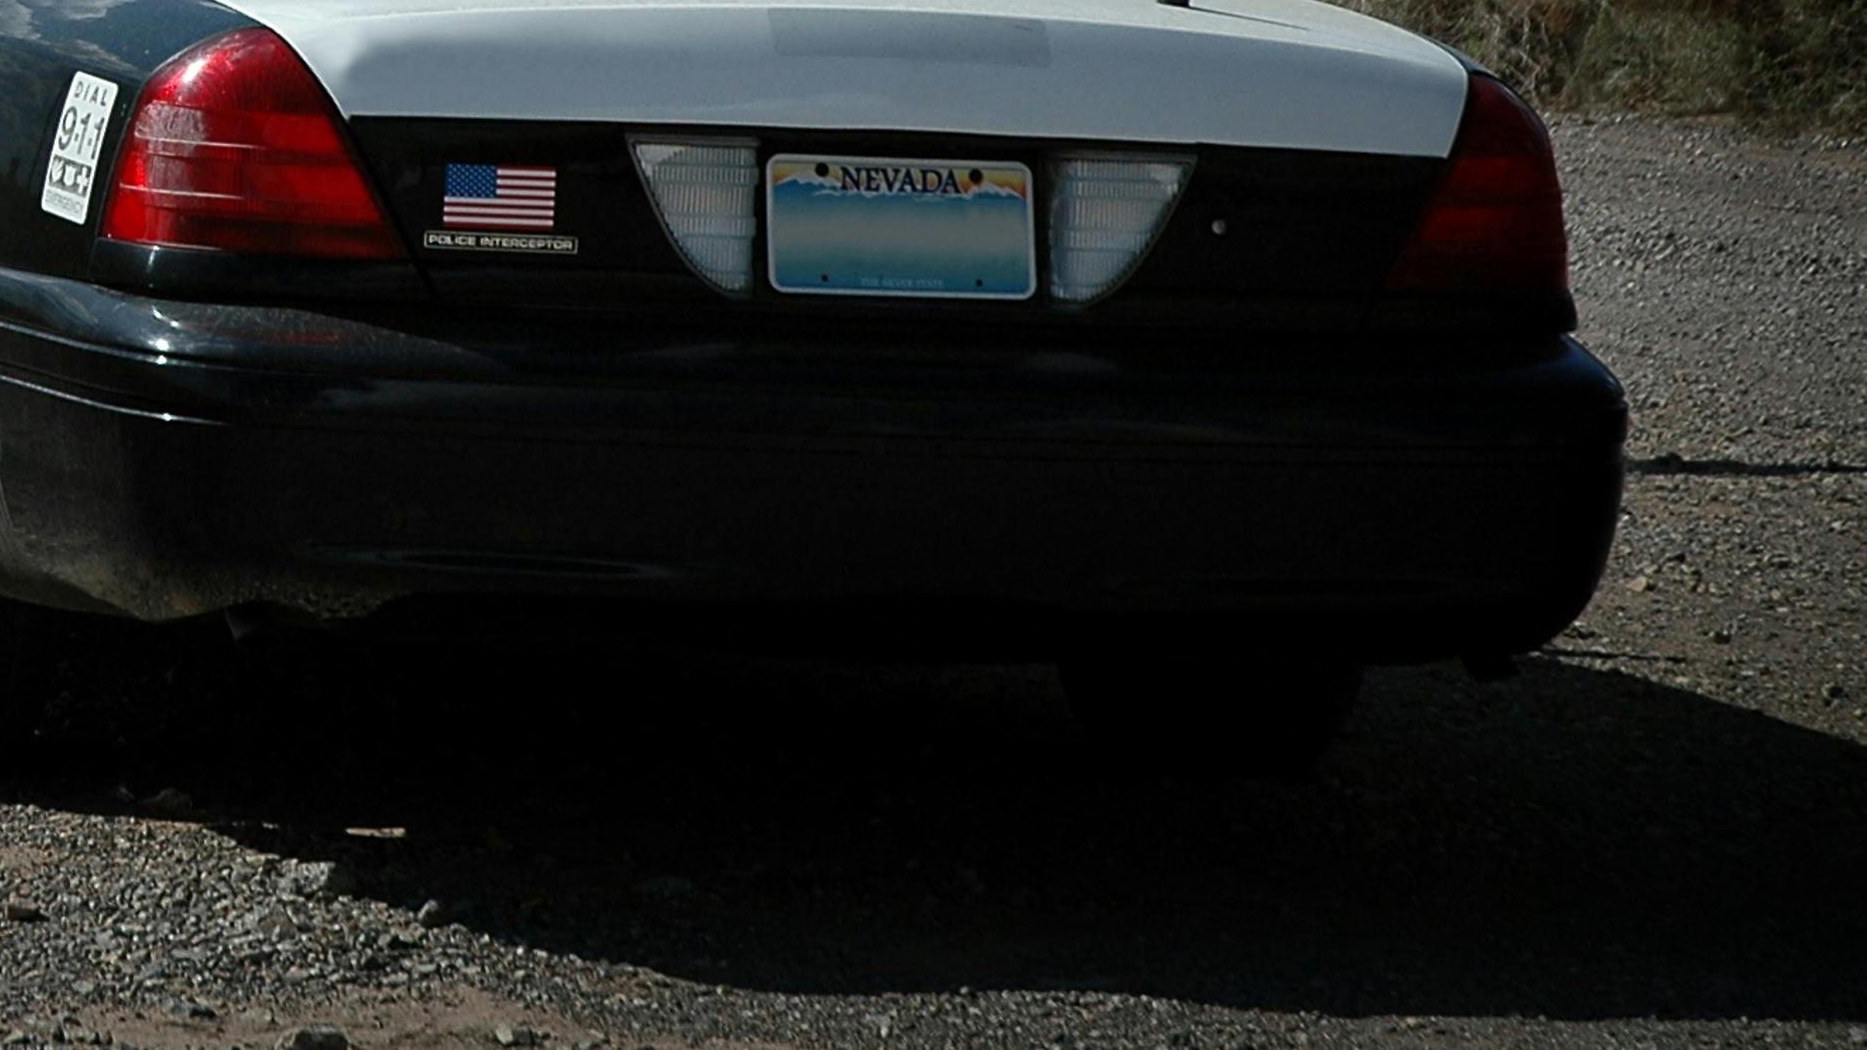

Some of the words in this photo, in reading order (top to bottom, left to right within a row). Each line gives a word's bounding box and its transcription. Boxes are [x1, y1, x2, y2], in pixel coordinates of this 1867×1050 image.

[73, 80, 108, 108] DIAL
[839, 165, 962, 195] NEVADA
[428, 234, 476, 246] POLICE
[480, 236, 573, 250] INTERCEPTOR
